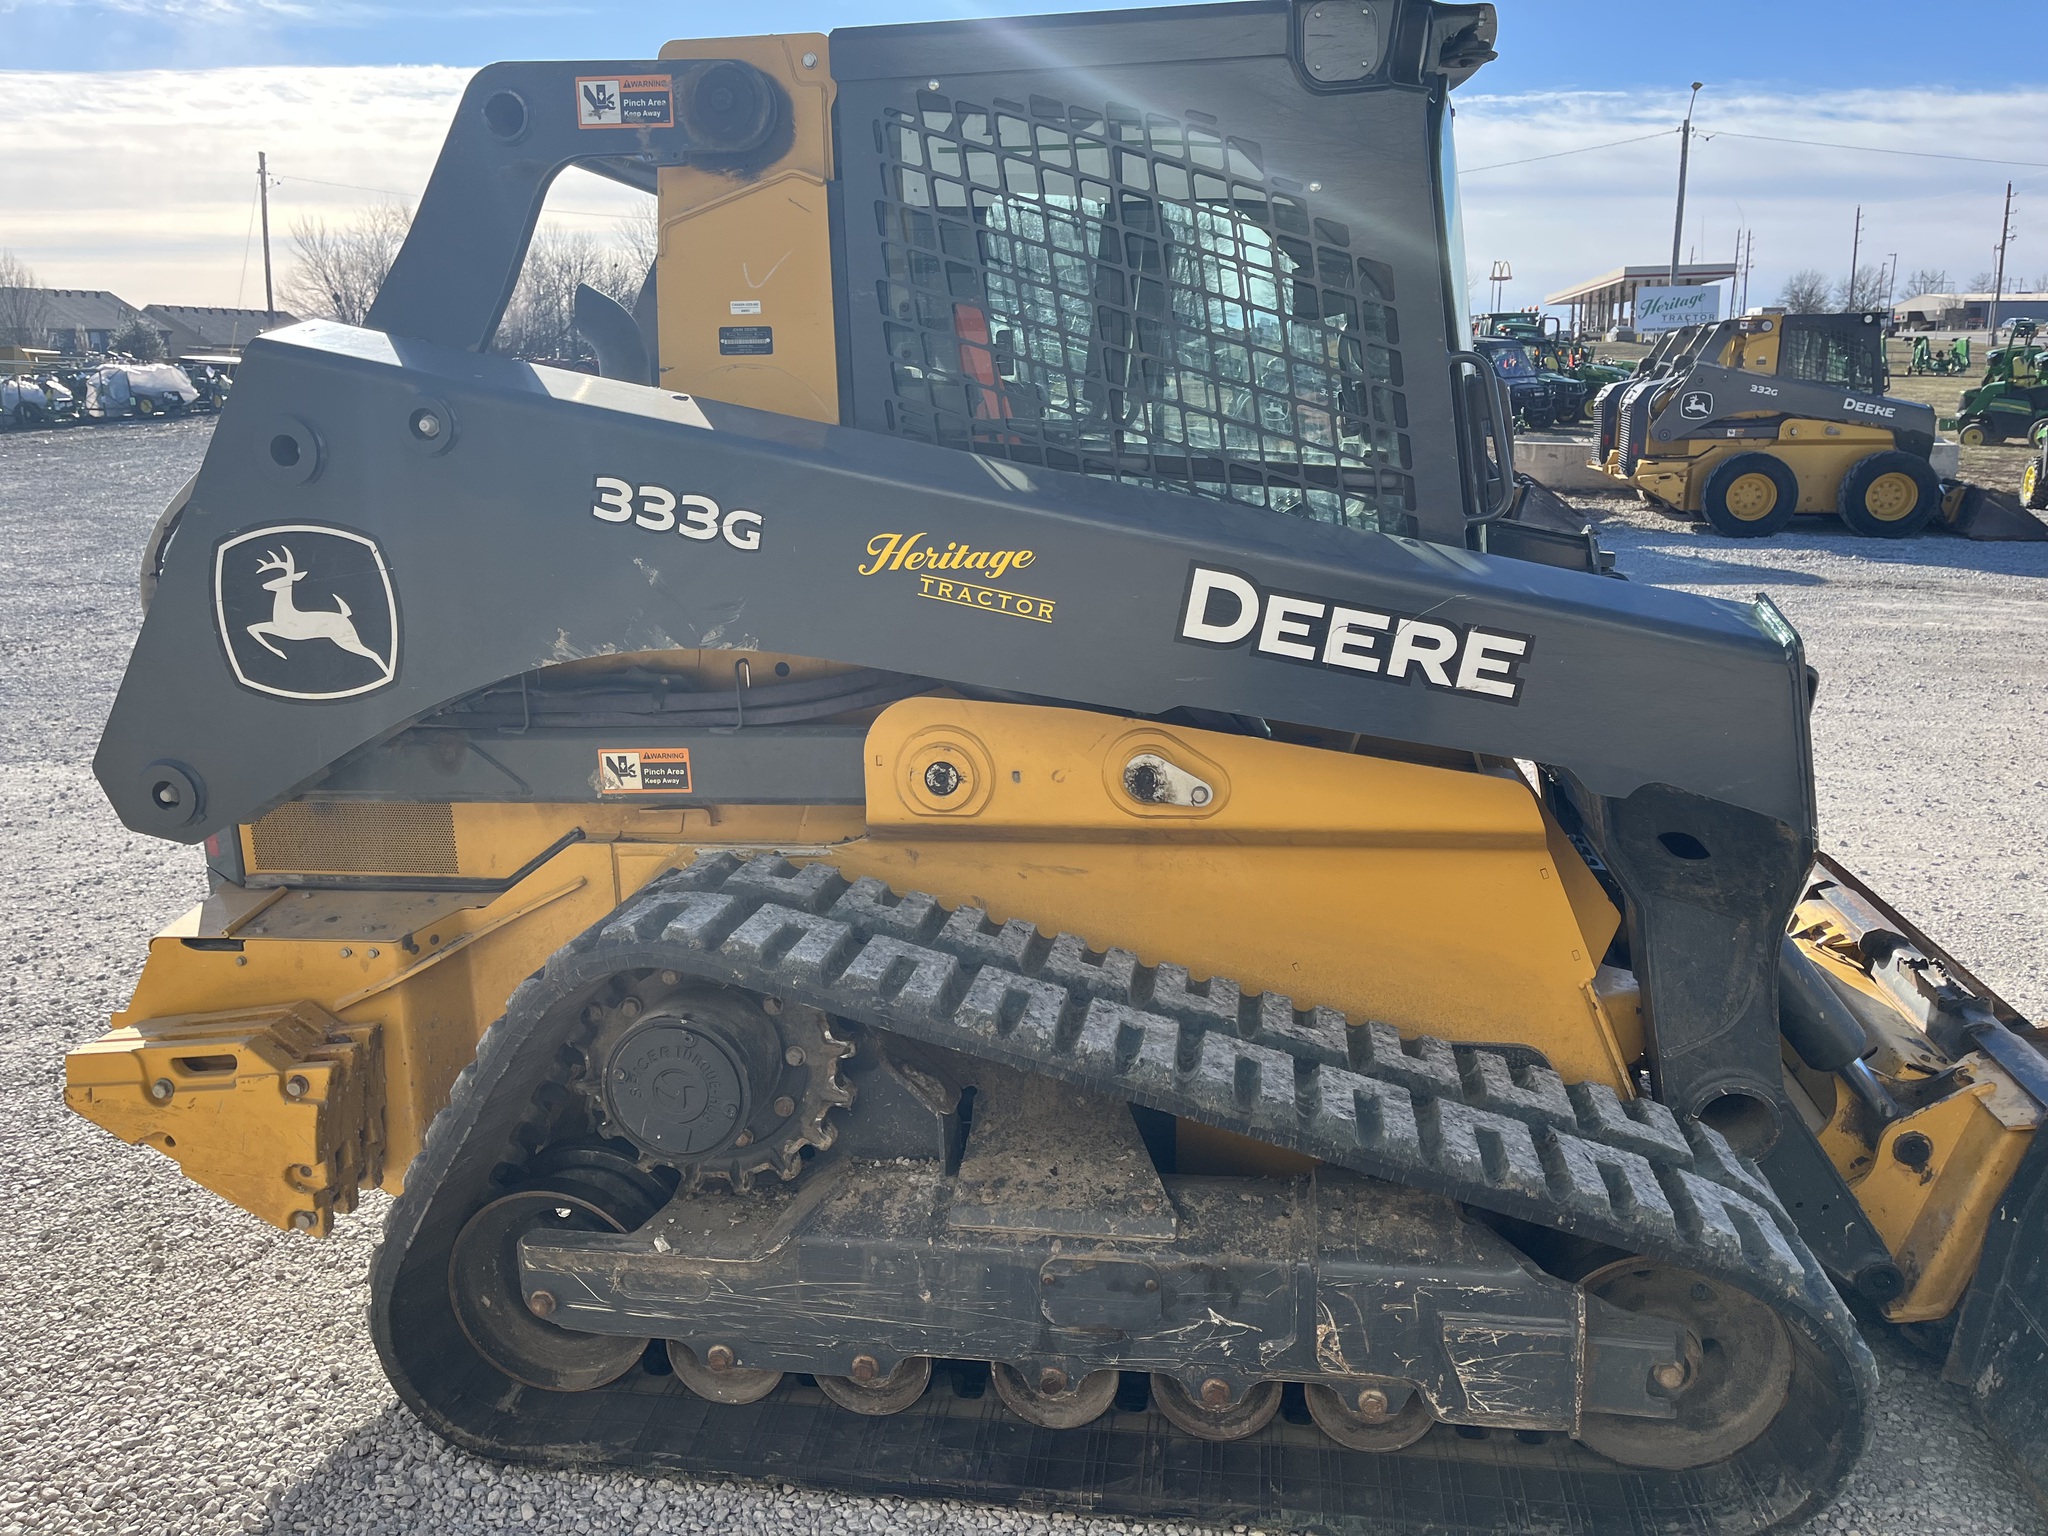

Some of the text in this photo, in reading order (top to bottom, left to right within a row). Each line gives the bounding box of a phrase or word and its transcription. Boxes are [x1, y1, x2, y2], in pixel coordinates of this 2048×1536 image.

[630, 80, 667, 88] WARNING
[623, 98, 667, 107] Pinch Area
[624, 110, 661, 118] Keep Away
[1638, 292, 1706, 320] Heritage
[1662, 313, 1715, 321] TRACTOR
[1749, 384, 1779, 397] 332G
[1842, 397, 1896, 418] DEERE
[592, 477, 763, 550] 333G
[858, 532, 1037, 579] Heritage
[919, 577, 1055, 619] TRACTOR
[1182, 567, 1527, 698] DEERE
[644, 777, 680, 785] Keep Away
